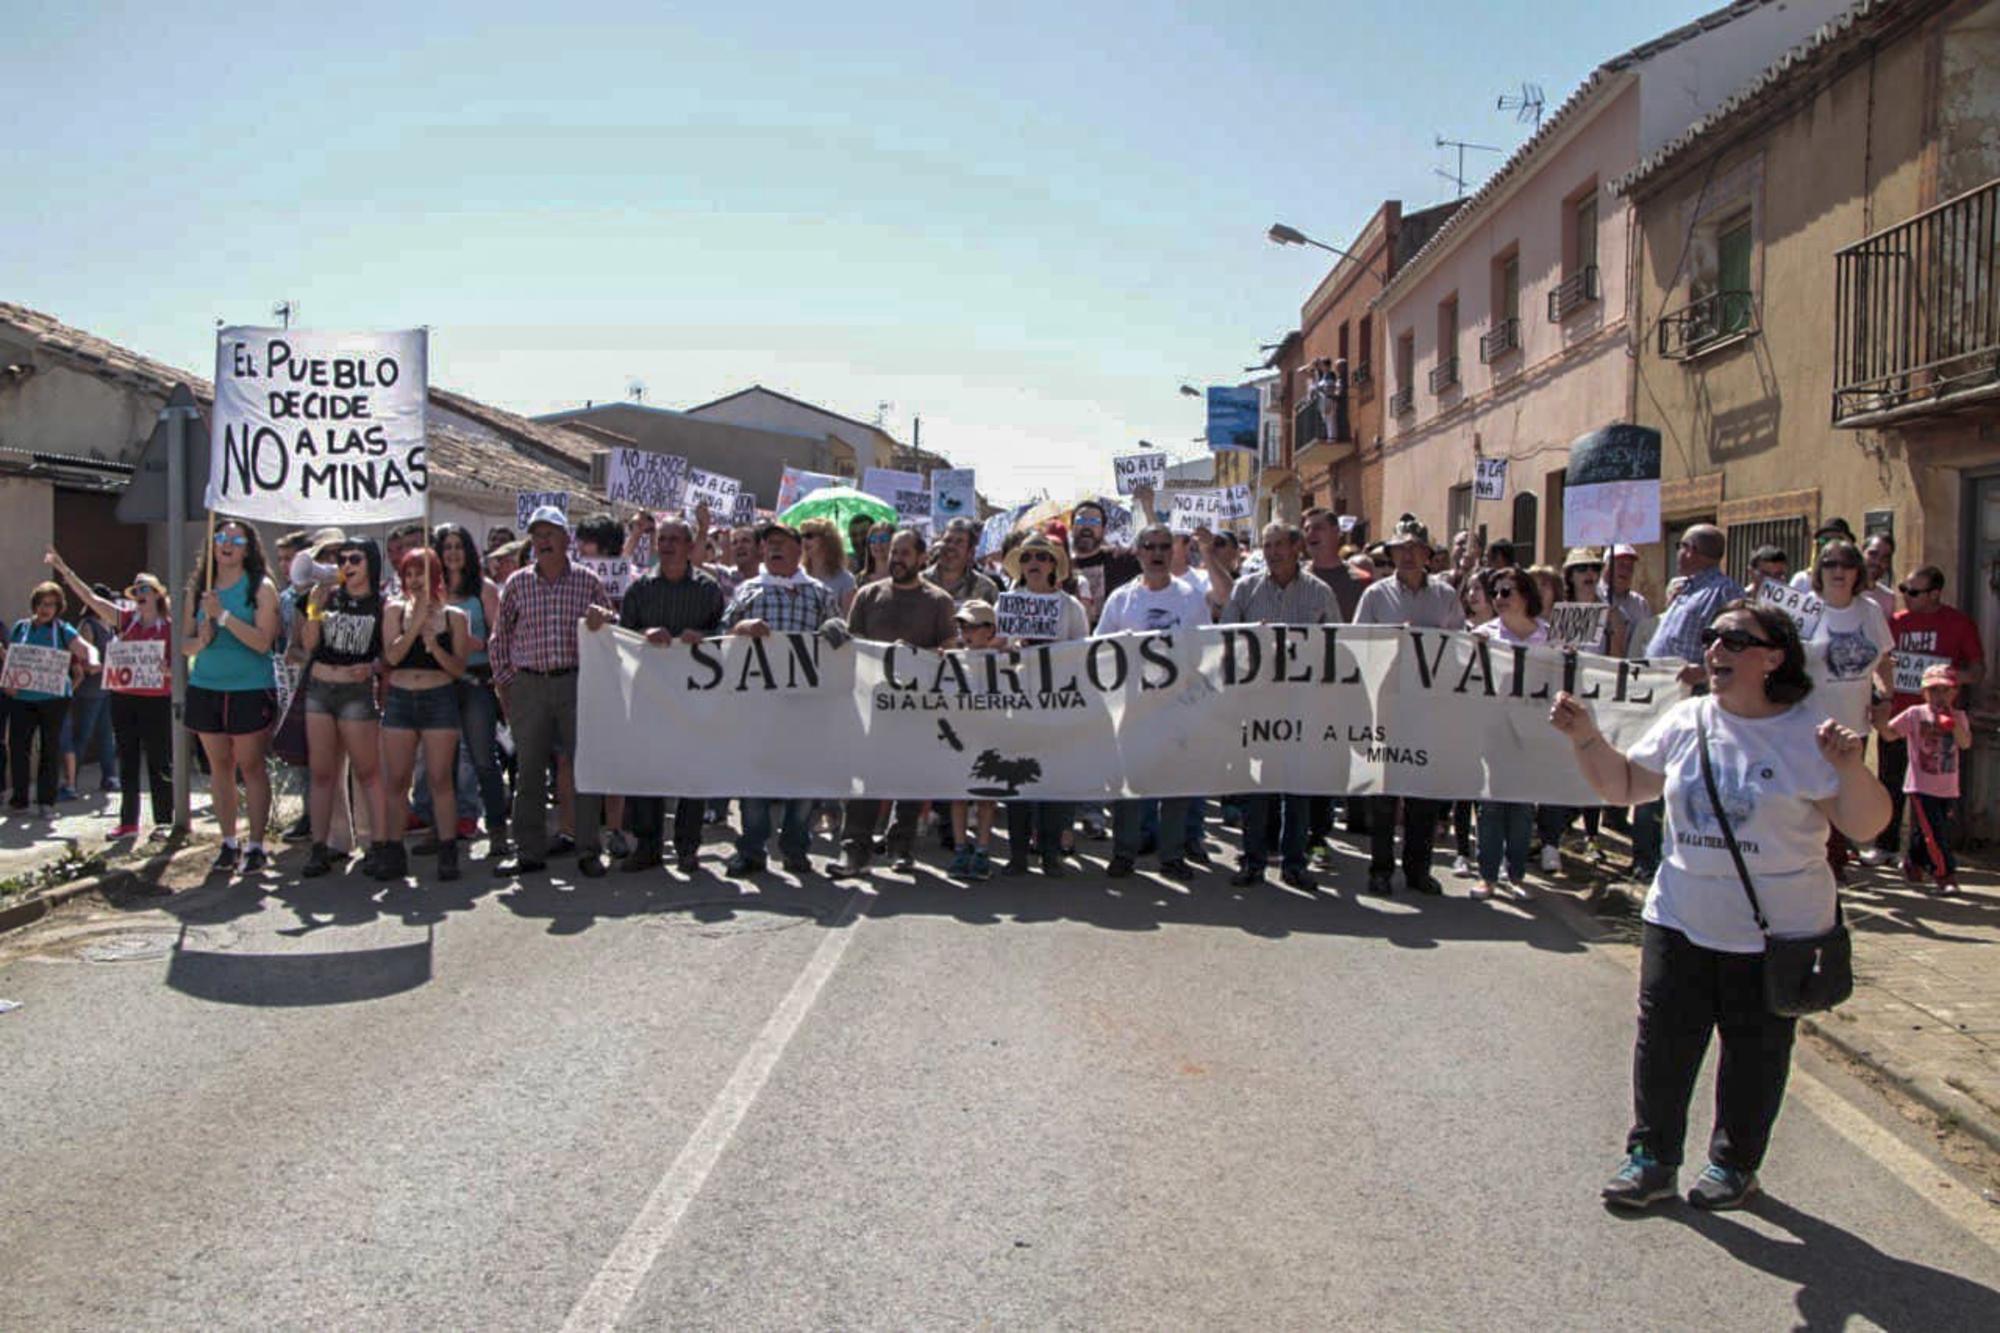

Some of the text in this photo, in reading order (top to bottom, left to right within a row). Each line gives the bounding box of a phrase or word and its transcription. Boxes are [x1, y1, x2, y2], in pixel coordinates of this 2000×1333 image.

[233, 339, 399, 389] EL PUEBLO
[268, 391, 372, 419] DECIDE
[222, 423, 388, 496] NO A LAS
[620, 449, 640, 468] NO
[1115, 456, 1166, 475] NO A LA
[300, 446, 428, 502] MINAS
[1478, 463, 1504, 478] A LA
[688, 472, 736, 496] NO A LA
[1174, 496, 1192, 511] NO
[1195, 497, 1204, 512] A
[612, 562, 628, 576] LA
[1761, 583, 1822, 615] NO A LA
[687, 627, 1654, 704] SAN CARLOS DEL VALLE
[3, 669, 32, 688] NO
[106, 667, 132, 686] NO
[1896, 673, 1921, 687] MIN
[876, 691, 1086, 710] SI A LA TIERRA VIVA
[1323, 725, 1337, 741] A
[1348, 725, 1386, 742] LAS
[1366, 747, 1428, 767] MINAS
